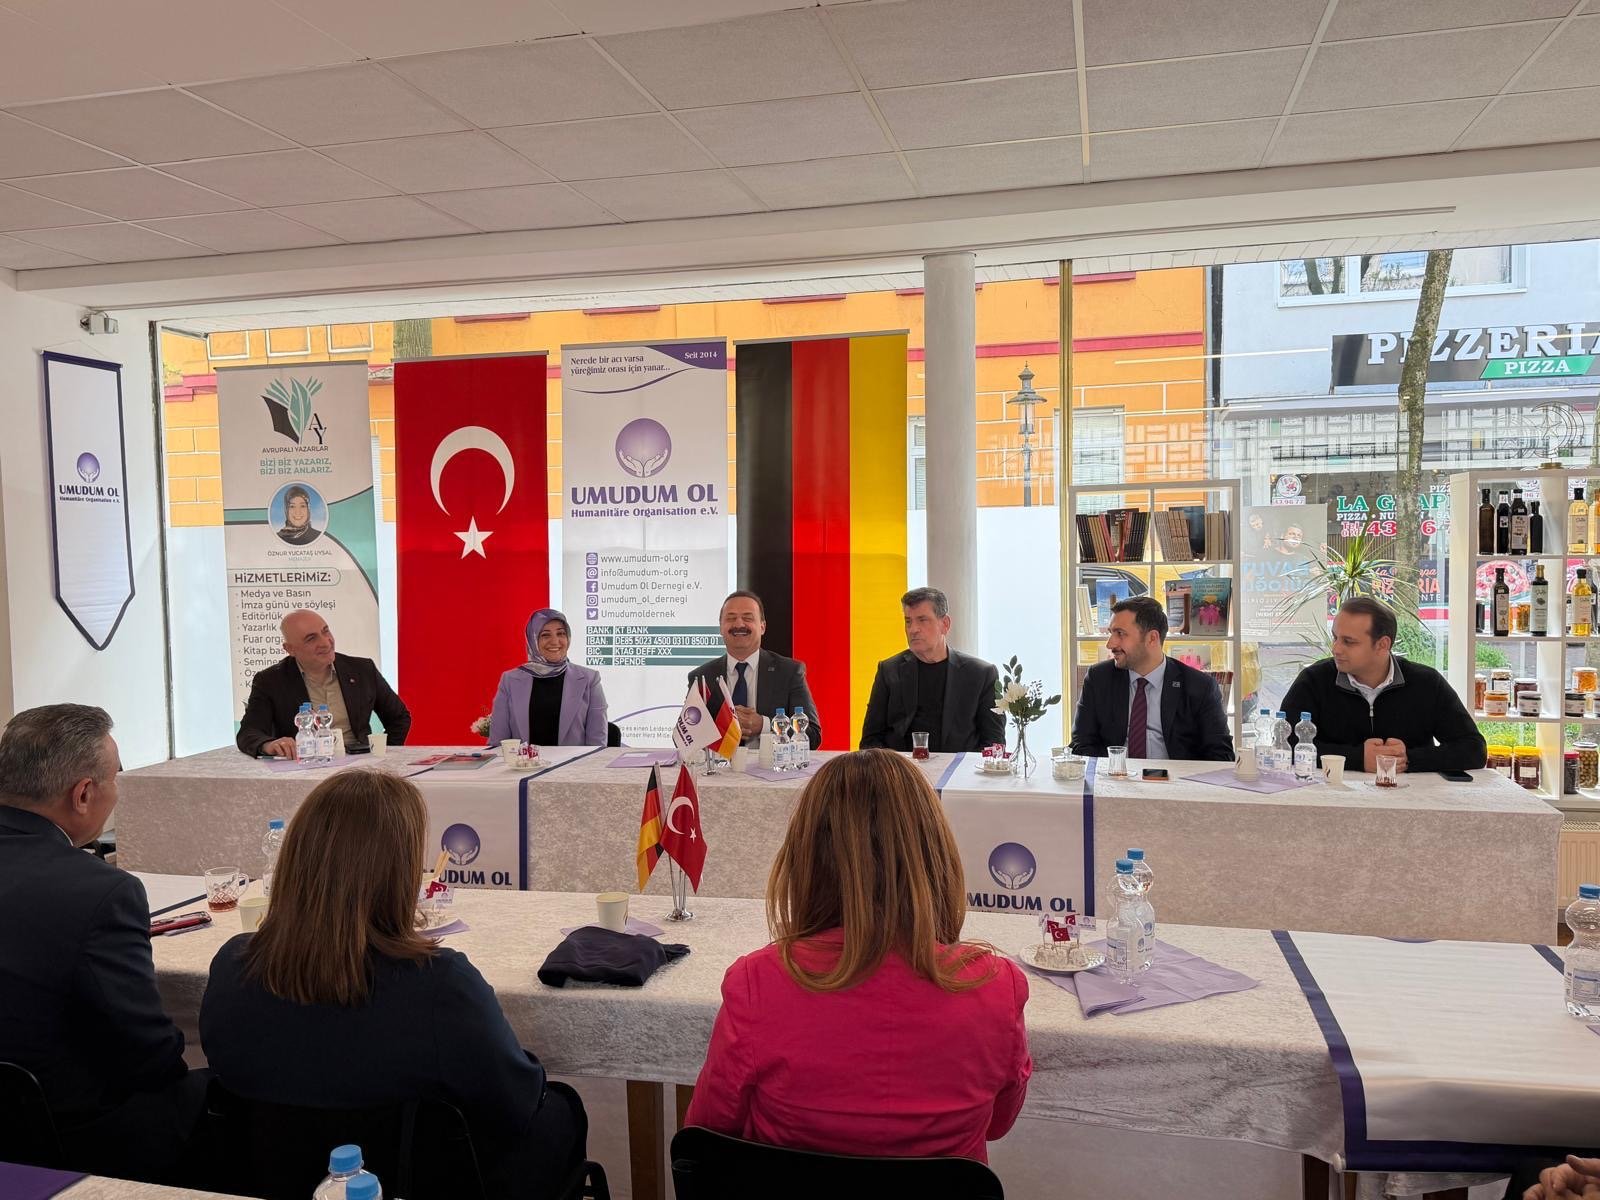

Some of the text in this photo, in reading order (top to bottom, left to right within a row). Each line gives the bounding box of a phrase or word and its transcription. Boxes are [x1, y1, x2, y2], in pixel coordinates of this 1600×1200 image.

[1367, 323, 1600, 365] PIZZERI
[570, 355, 644, 366] Nerede bir acı varsa
[684, 351, 718, 360] Seit 2014
[570, 366, 606, 377] yüreğimiz
[607, 365, 627, 373] orası
[628, 364, 642, 375] için
[1504, 360, 1571, 375] PIZZA
[295, 445, 329, 453] YAZARLAR
[260, 458, 276, 467] BİZİ
[278, 457, 292, 466] BİZ
[278, 466, 292, 475] BİZ
[59, 484, 120, 497] UMUDUM OL
[571, 483, 718, 505] UMUDUM OL
[1337, 495, 1369, 512] LA
[571, 506, 719, 518] Humanitäre Organisation e.V.
[1336, 512, 1367, 520] PIZZA
[1366, 520, 1397, 537] 43
[1420, 520, 1437, 536] 6
[600, 553, 689, 564] www.umudum-ol.org
[600, 567, 689, 578] info@umudum-ol.org
[601, 581, 703, 592] Umudum Ol Dernegi e.V.
[240, 589, 312, 599] Medya ve Basın
[265, 601, 291, 611] günü
[292, 601, 303, 609] ve
[304, 599, 336, 610] söyleşi
[601, 595, 688, 605] umudum_ol_dernegi
[242, 612, 283, 621] Editörlük
[601, 609, 676, 619] Umudumoldernek
[242, 623, 277, 632] Yazarlık
[615, 626, 626, 635] KT
[627, 626, 649, 635] BANK
[243, 634, 263, 644] Fuar
[615, 636, 633, 645] DE85
[635, 636, 652, 645] 5023
[653, 636, 671, 645] 4500
[672, 636, 690, 645] 0310
[691, 636, 709, 645] 8500
[710, 636, 719, 645] 01
[243, 646, 268, 657] Kitap
[615, 647, 634, 656] KTAG
[636, 647, 656, 656] DEFF
[657, 647, 673, 655] XXX
[614, 657, 646, 666] SPENDE
[431, 868, 513, 886] UDUM OL
[966, 892, 1077, 912] MUDUM OL
